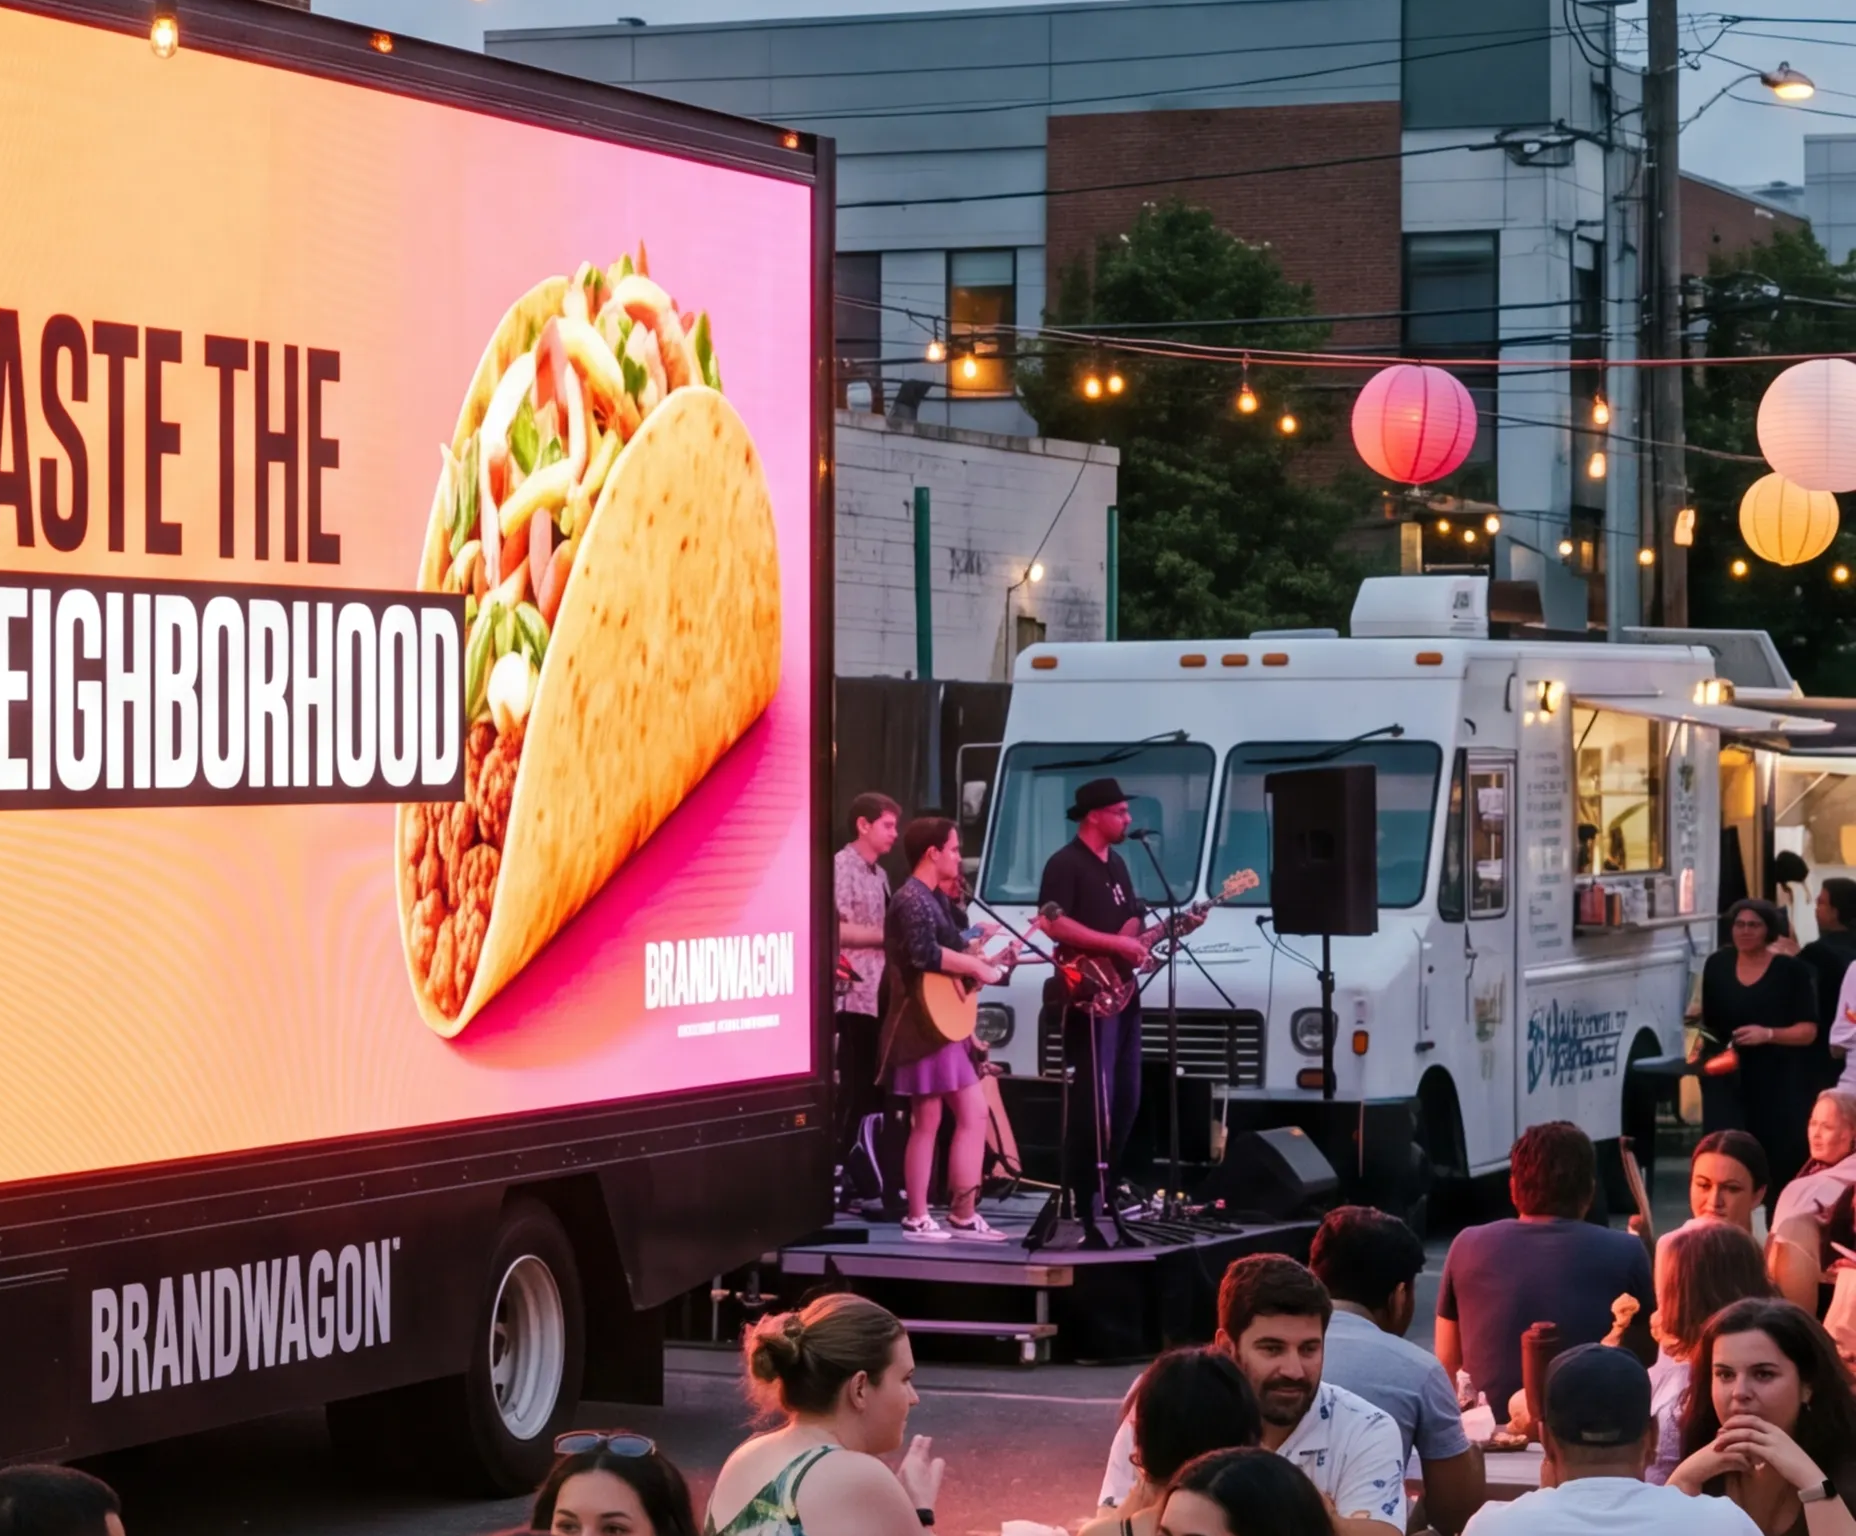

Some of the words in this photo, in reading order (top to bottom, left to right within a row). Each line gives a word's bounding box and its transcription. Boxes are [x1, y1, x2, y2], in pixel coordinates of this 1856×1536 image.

[204, 333, 341, 565] THE
[645, 931, 794, 1010] BRANDWAGON
[91, 1238, 391, 1404] BRANDWAGON
